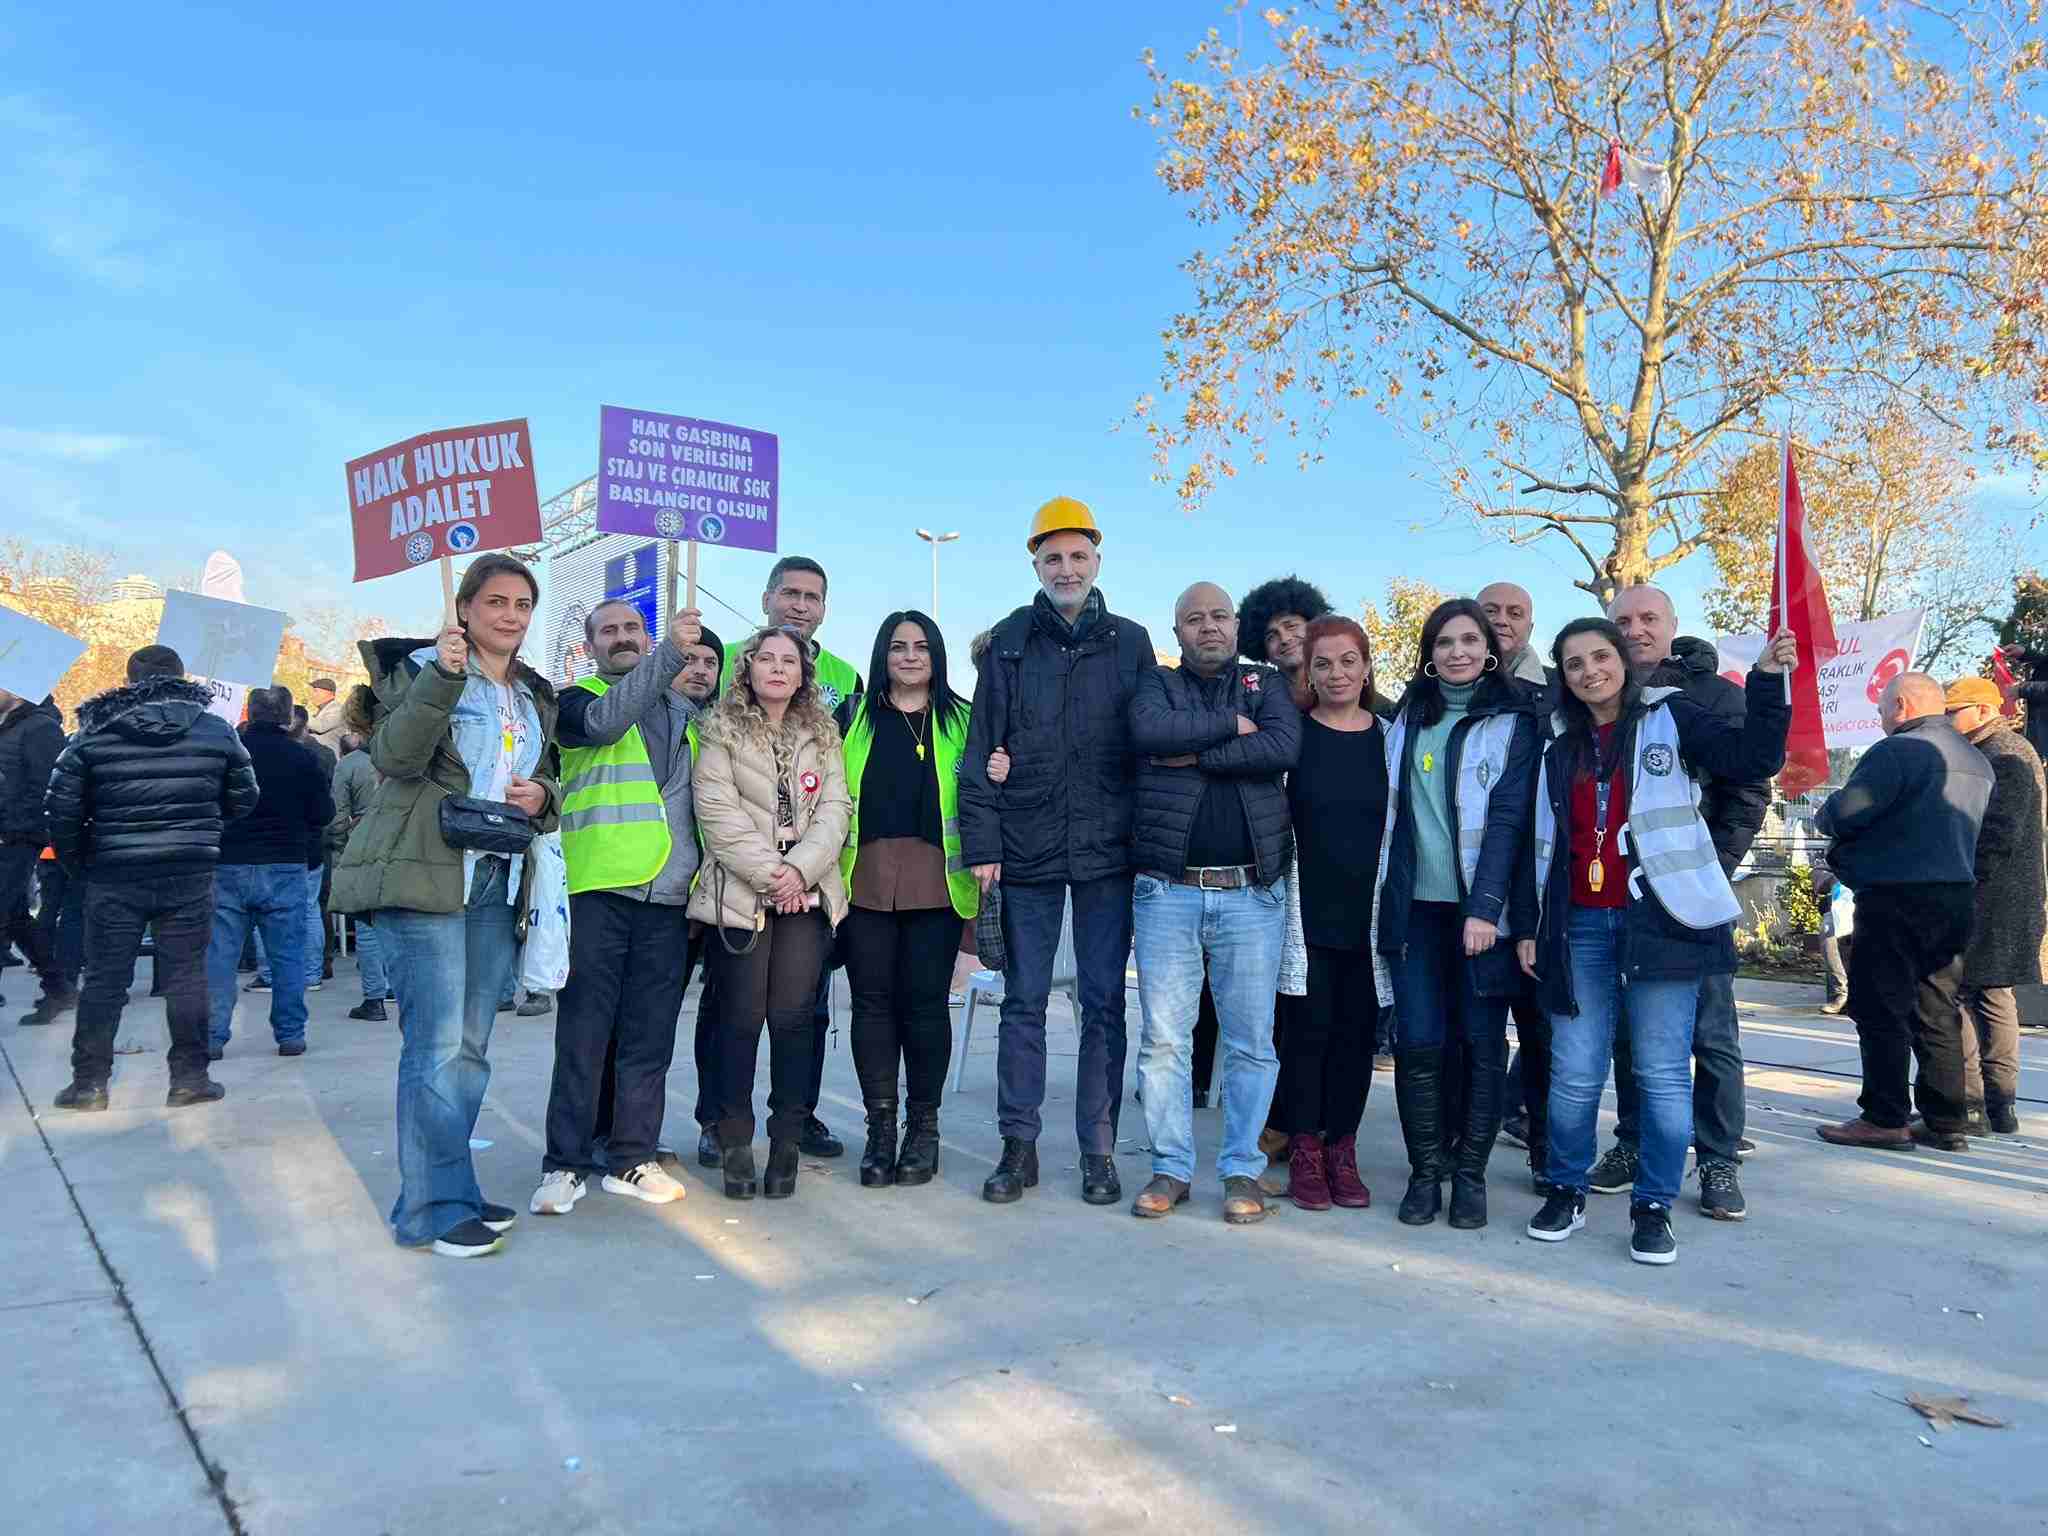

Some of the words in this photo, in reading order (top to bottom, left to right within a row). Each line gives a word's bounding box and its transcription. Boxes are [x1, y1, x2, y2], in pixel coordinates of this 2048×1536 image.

[628, 438, 665, 459] SON
[632, 418, 671, 440] HAK
[675, 425, 753, 453] GASBINA
[353, 454, 409, 507] HAK
[414, 432, 525, 485] HUKUK
[607, 457, 643, 480] STAJ
[648, 462, 667, 483] VE
[671, 466, 739, 495] ÇIRAKLIK
[743, 477, 771, 500] SGK
[389, 479, 492, 541] ADALET
[608, 483, 712, 513] BAŞLANGICI
[716, 498, 769, 522] OLSUN
[1819, 660, 1867, 681] RAKLIK
